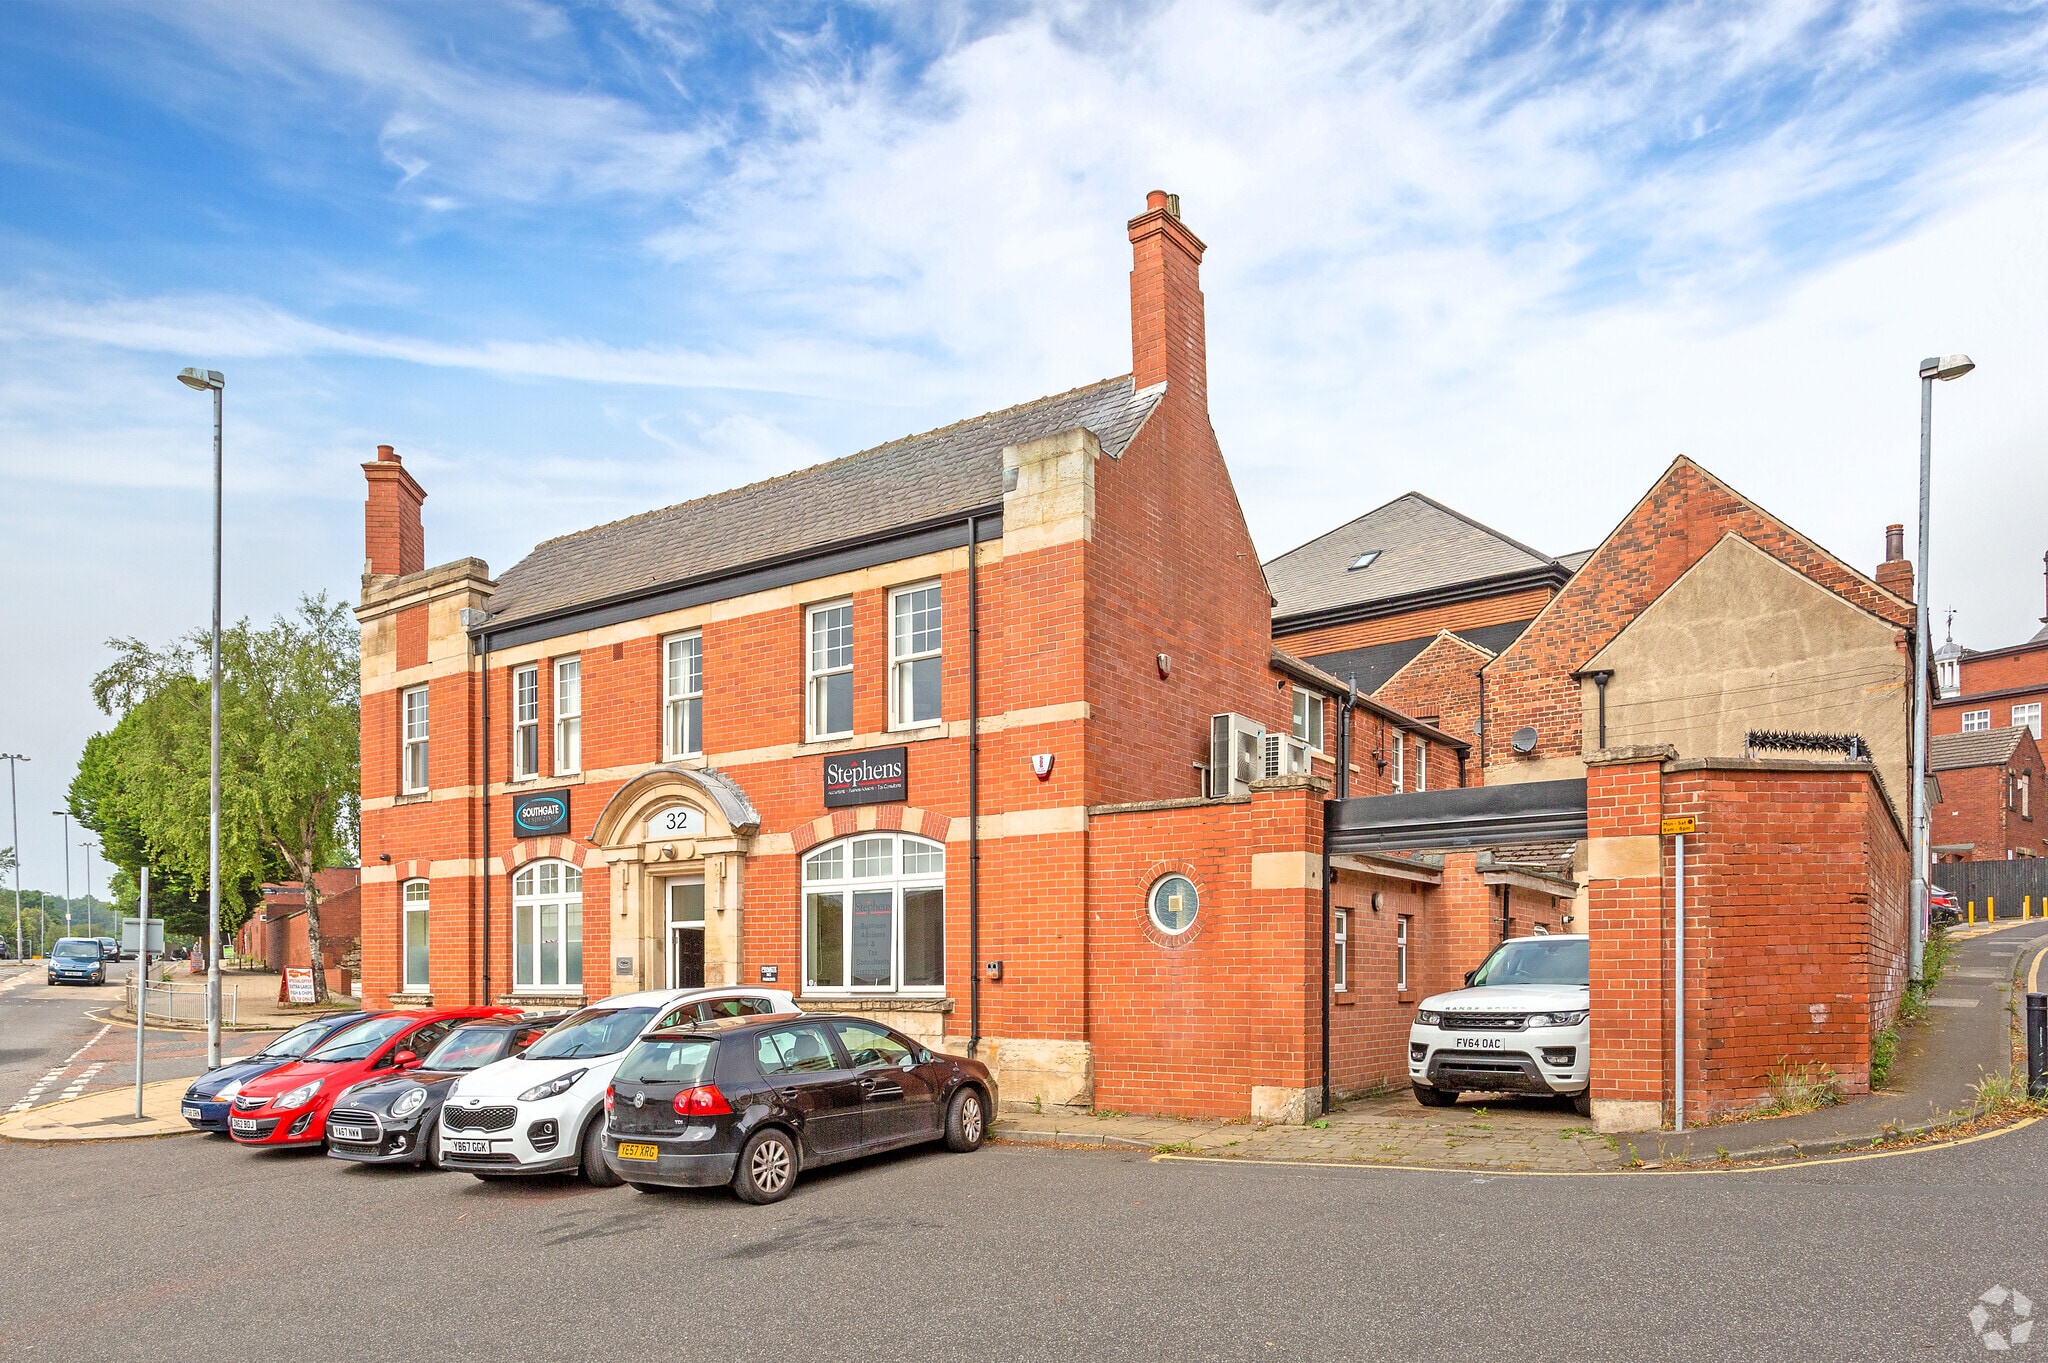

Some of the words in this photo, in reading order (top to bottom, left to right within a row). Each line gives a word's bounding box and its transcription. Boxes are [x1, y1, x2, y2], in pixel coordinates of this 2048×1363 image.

[827, 760, 902, 787] Stephens
[522, 804, 559, 817] SOUTHGATE
[666, 811, 687, 830] 32
[855, 900, 892, 914] Stephens
[1456, 1038, 1480, 1048] FV64
[1482, 1039, 1501, 1048] OAC
[452, 1141, 471, 1151] YB67
[472, 1142, 487, 1152] GGK
[621, 1143, 639, 1155] YE57
[639, 1145, 655, 1157] XRG
